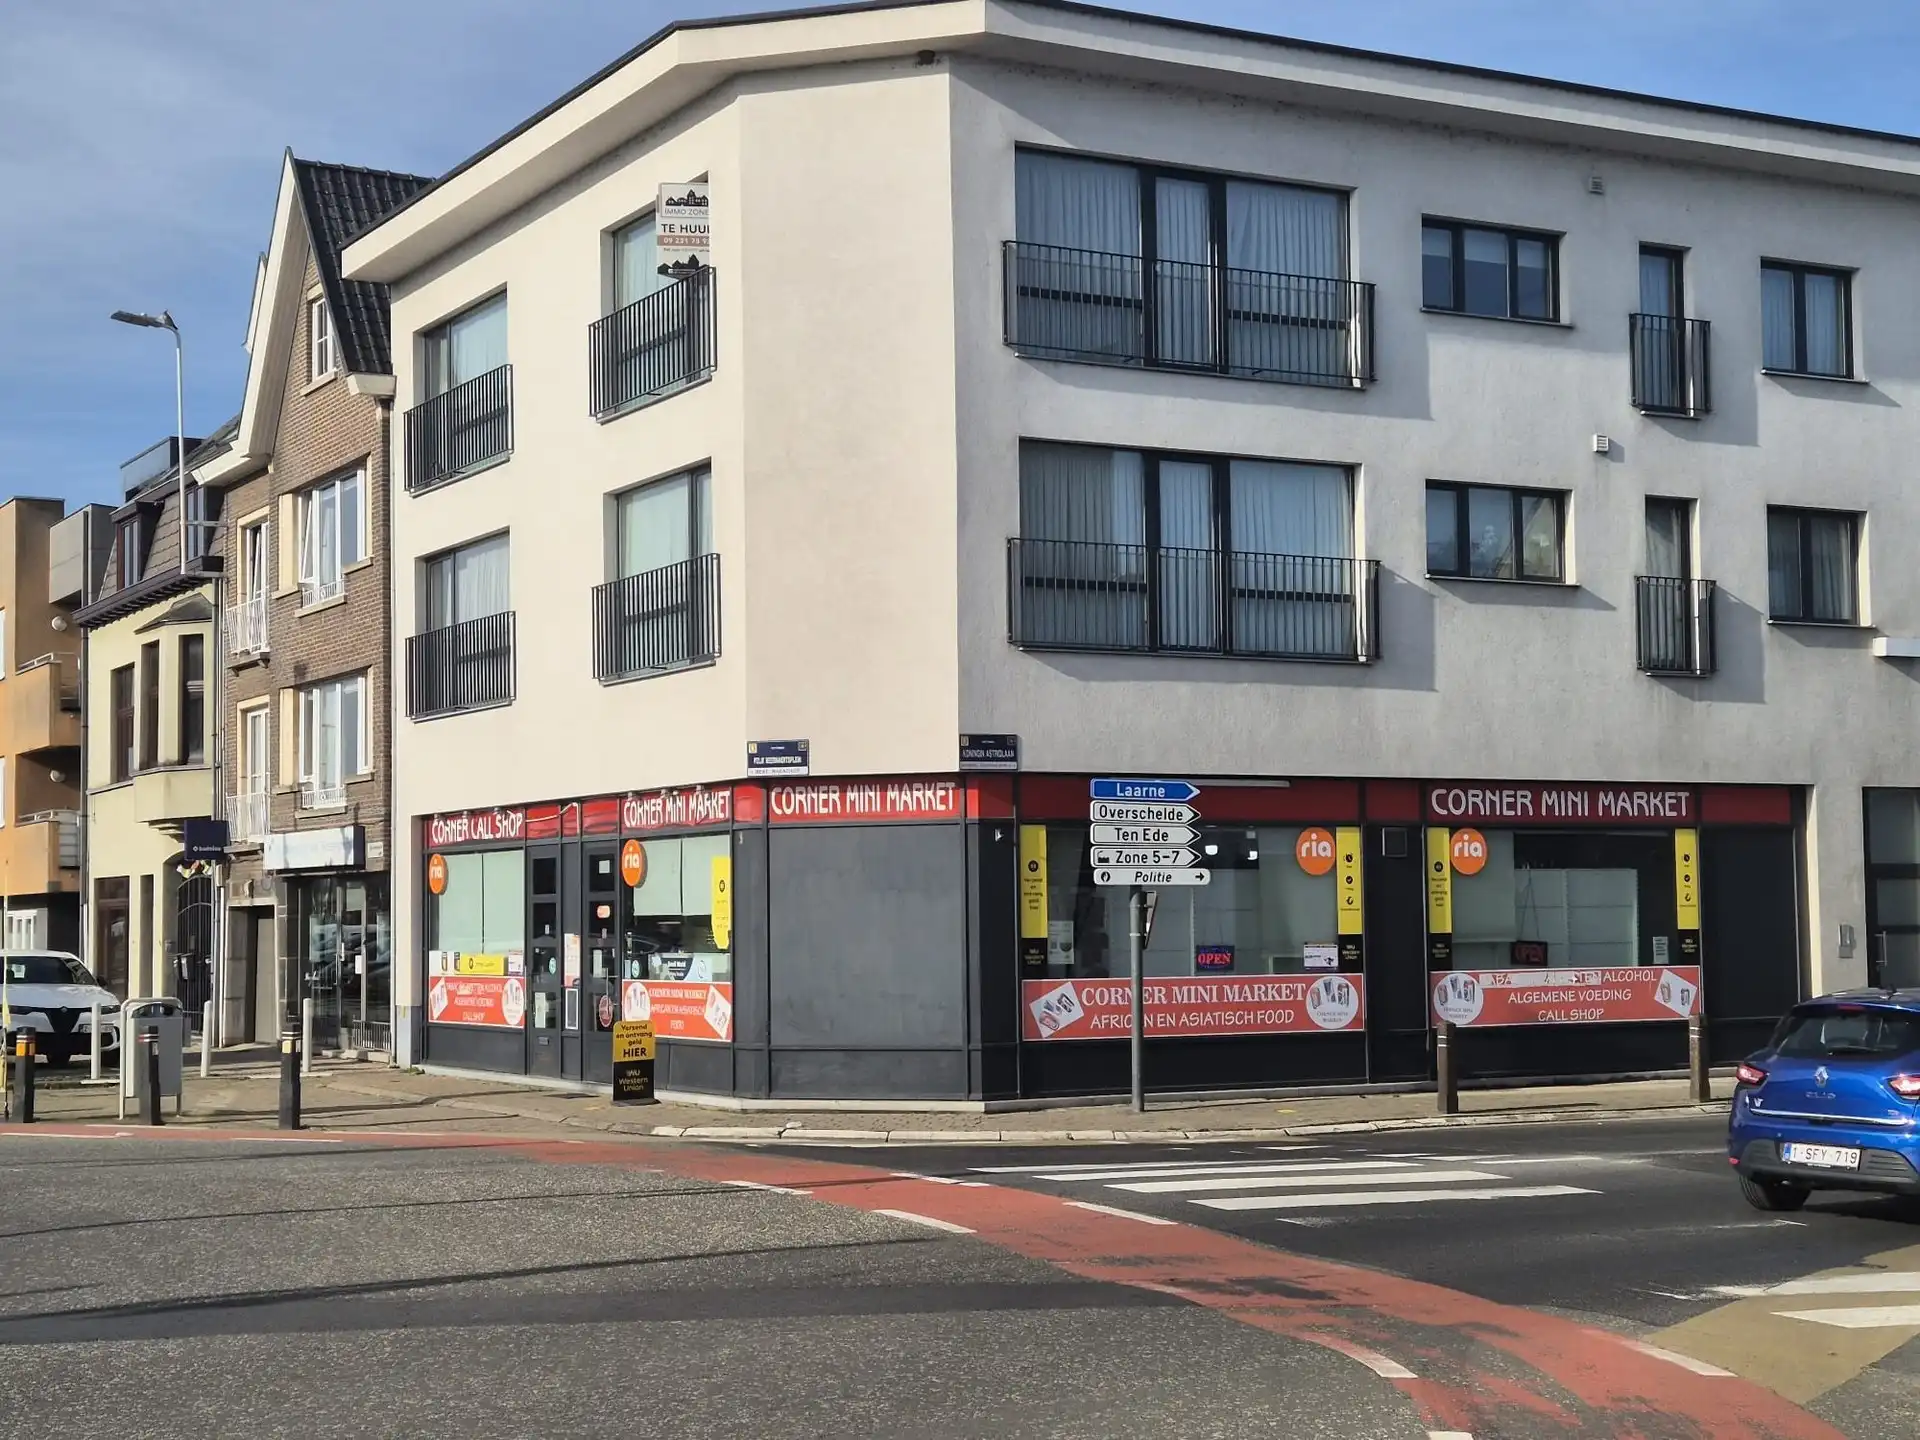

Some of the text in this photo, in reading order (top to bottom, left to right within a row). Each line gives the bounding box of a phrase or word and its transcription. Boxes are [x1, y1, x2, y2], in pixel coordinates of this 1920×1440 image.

[661, 224, 676, 233] TE
[1116, 782, 1165, 797] Laarne
[770, 781, 956, 815] CORNER MINI MARKET
[1431, 788, 1690, 817] CORNER MINI MARKET
[624, 790, 731, 828] CORNER MINI MARKET
[1099, 804, 1183, 820] Overschelde
[432, 812, 523, 843] CORNER CALL SHOP
[1115, 827, 1169, 841] Ten Ede
[1301, 833, 1331, 857] ria
[1453, 834, 1482, 857] ria
[624, 848, 640, 869] ria
[1116, 850, 1180, 863] Zone 5-7
[430, 859, 443, 880] ria
[1134, 871, 1172, 883] Politie
[1197, 952, 1231, 965] OPEN
[1603, 969, 1657, 983] ALCOHOL
[1172, 985, 1217, 1003] MINI
[1222, 983, 1306, 1002] MARKET
[1507, 987, 1632, 1004] ALGEMENE VOEDING
[1090, 1008, 1295, 1029] AFRICN EN ASIATISCH FOOD
[1537, 1008, 1605, 1022] CALL SHOP
[625, 1031, 652, 1039] ontvang
[628, 1039, 642, 1047] geld
[623, 1047, 647, 1058] HIER
[618, 1077, 649, 1085] Western
[623, 1084, 644, 1092] Union
